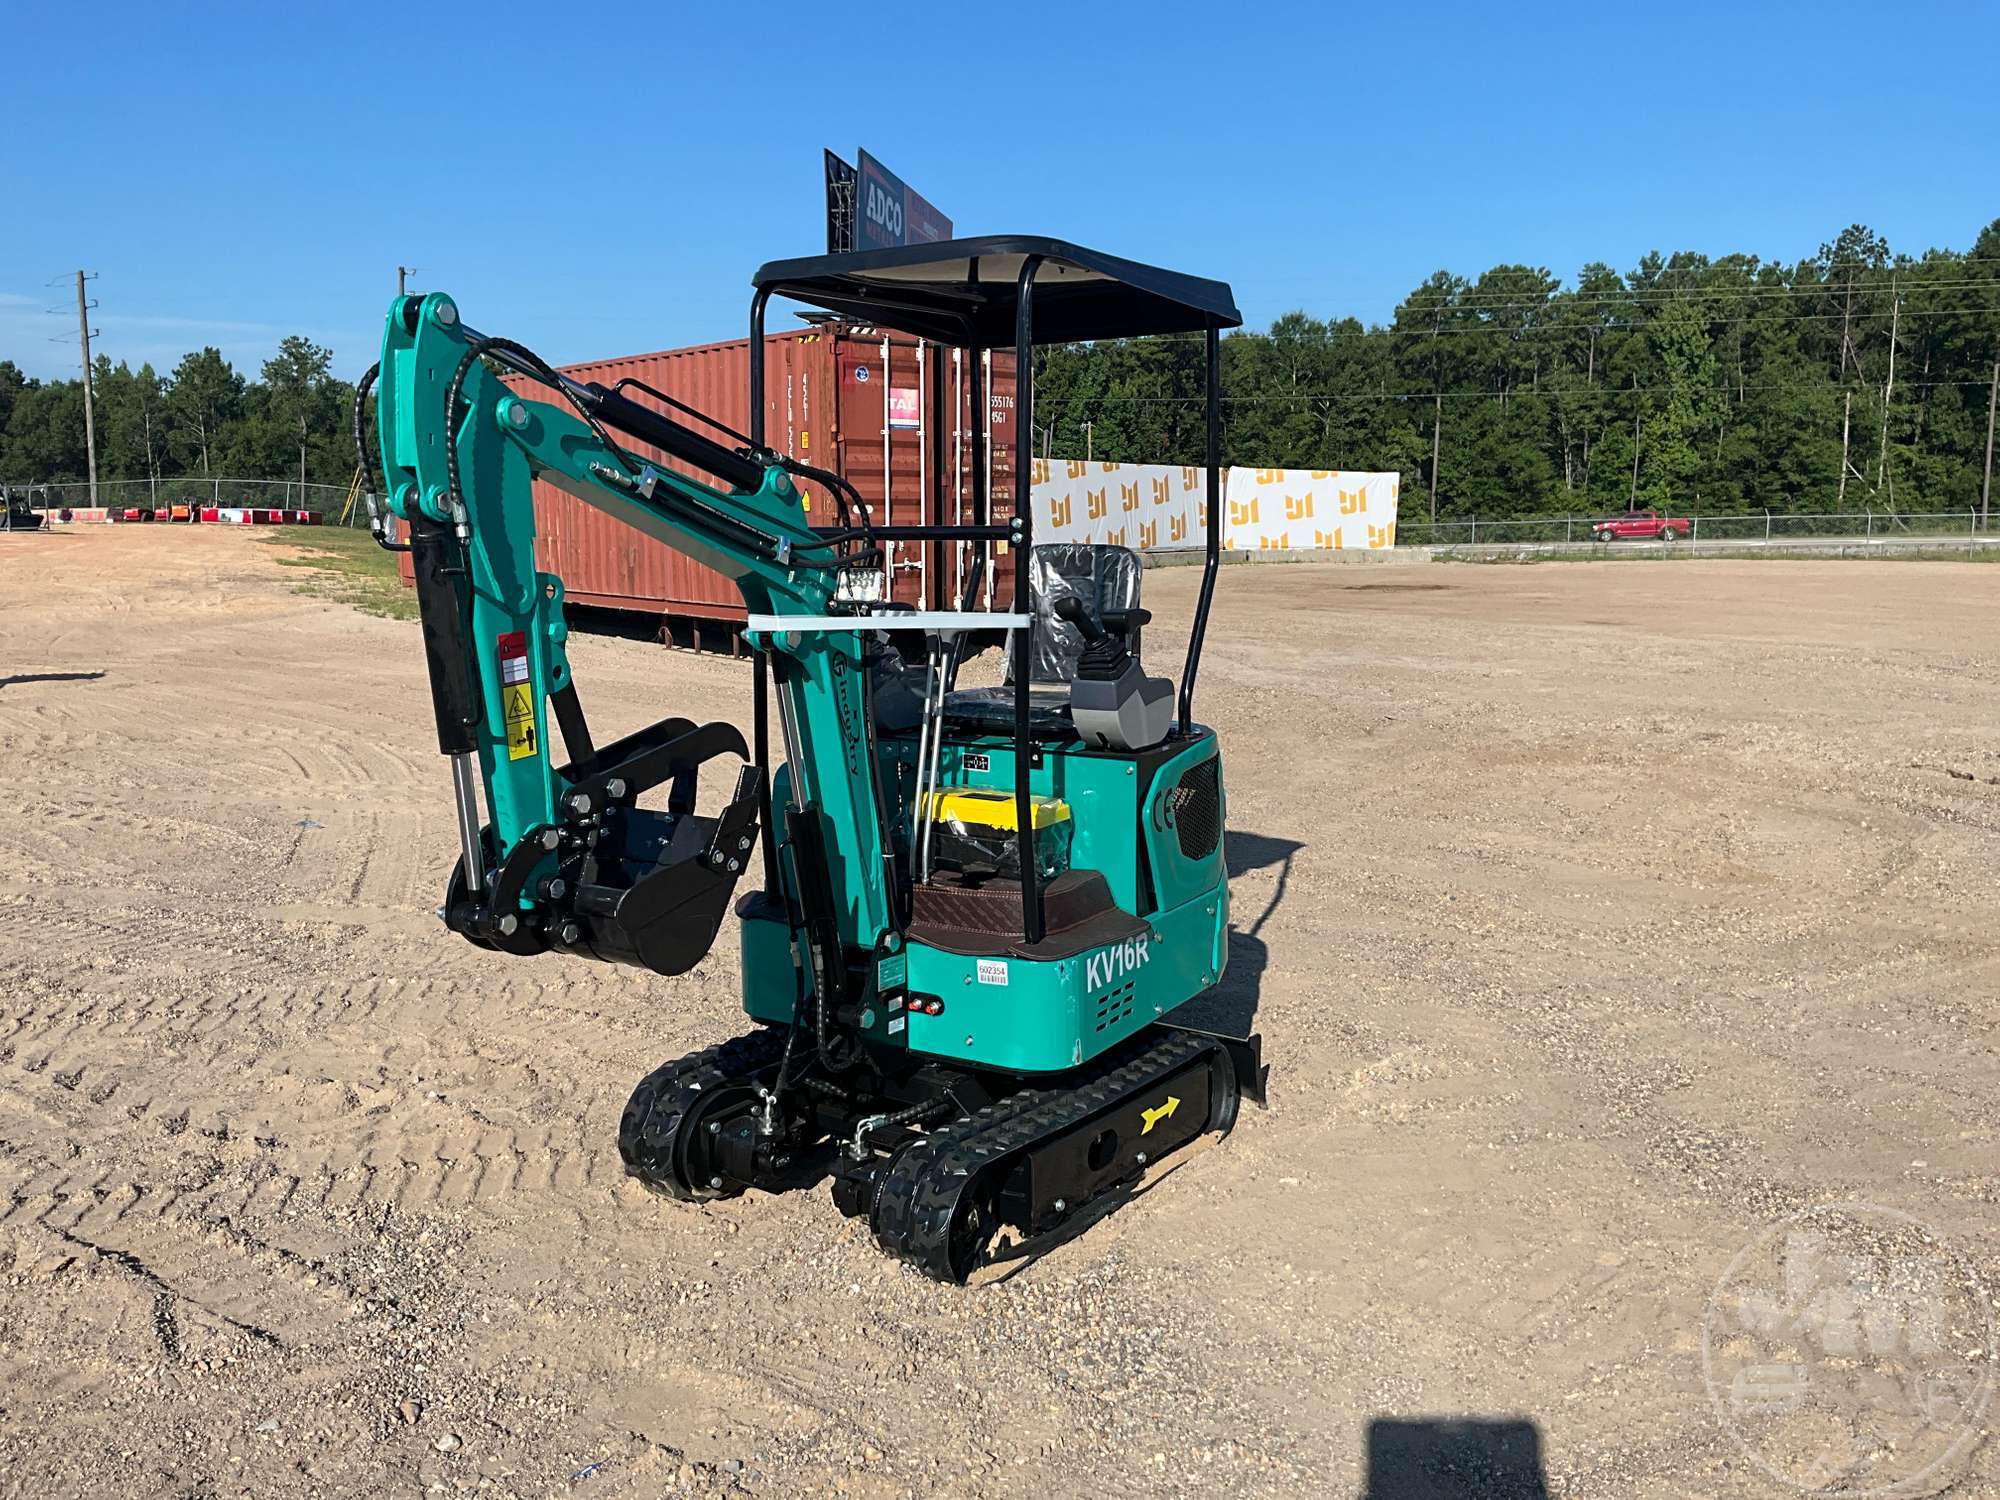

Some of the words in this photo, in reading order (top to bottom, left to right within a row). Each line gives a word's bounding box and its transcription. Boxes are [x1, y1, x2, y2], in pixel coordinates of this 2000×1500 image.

[866, 183, 902, 237] ADCO
[889, 398, 917, 410] TAL
[1086, 932, 1149, 993] KV16R
